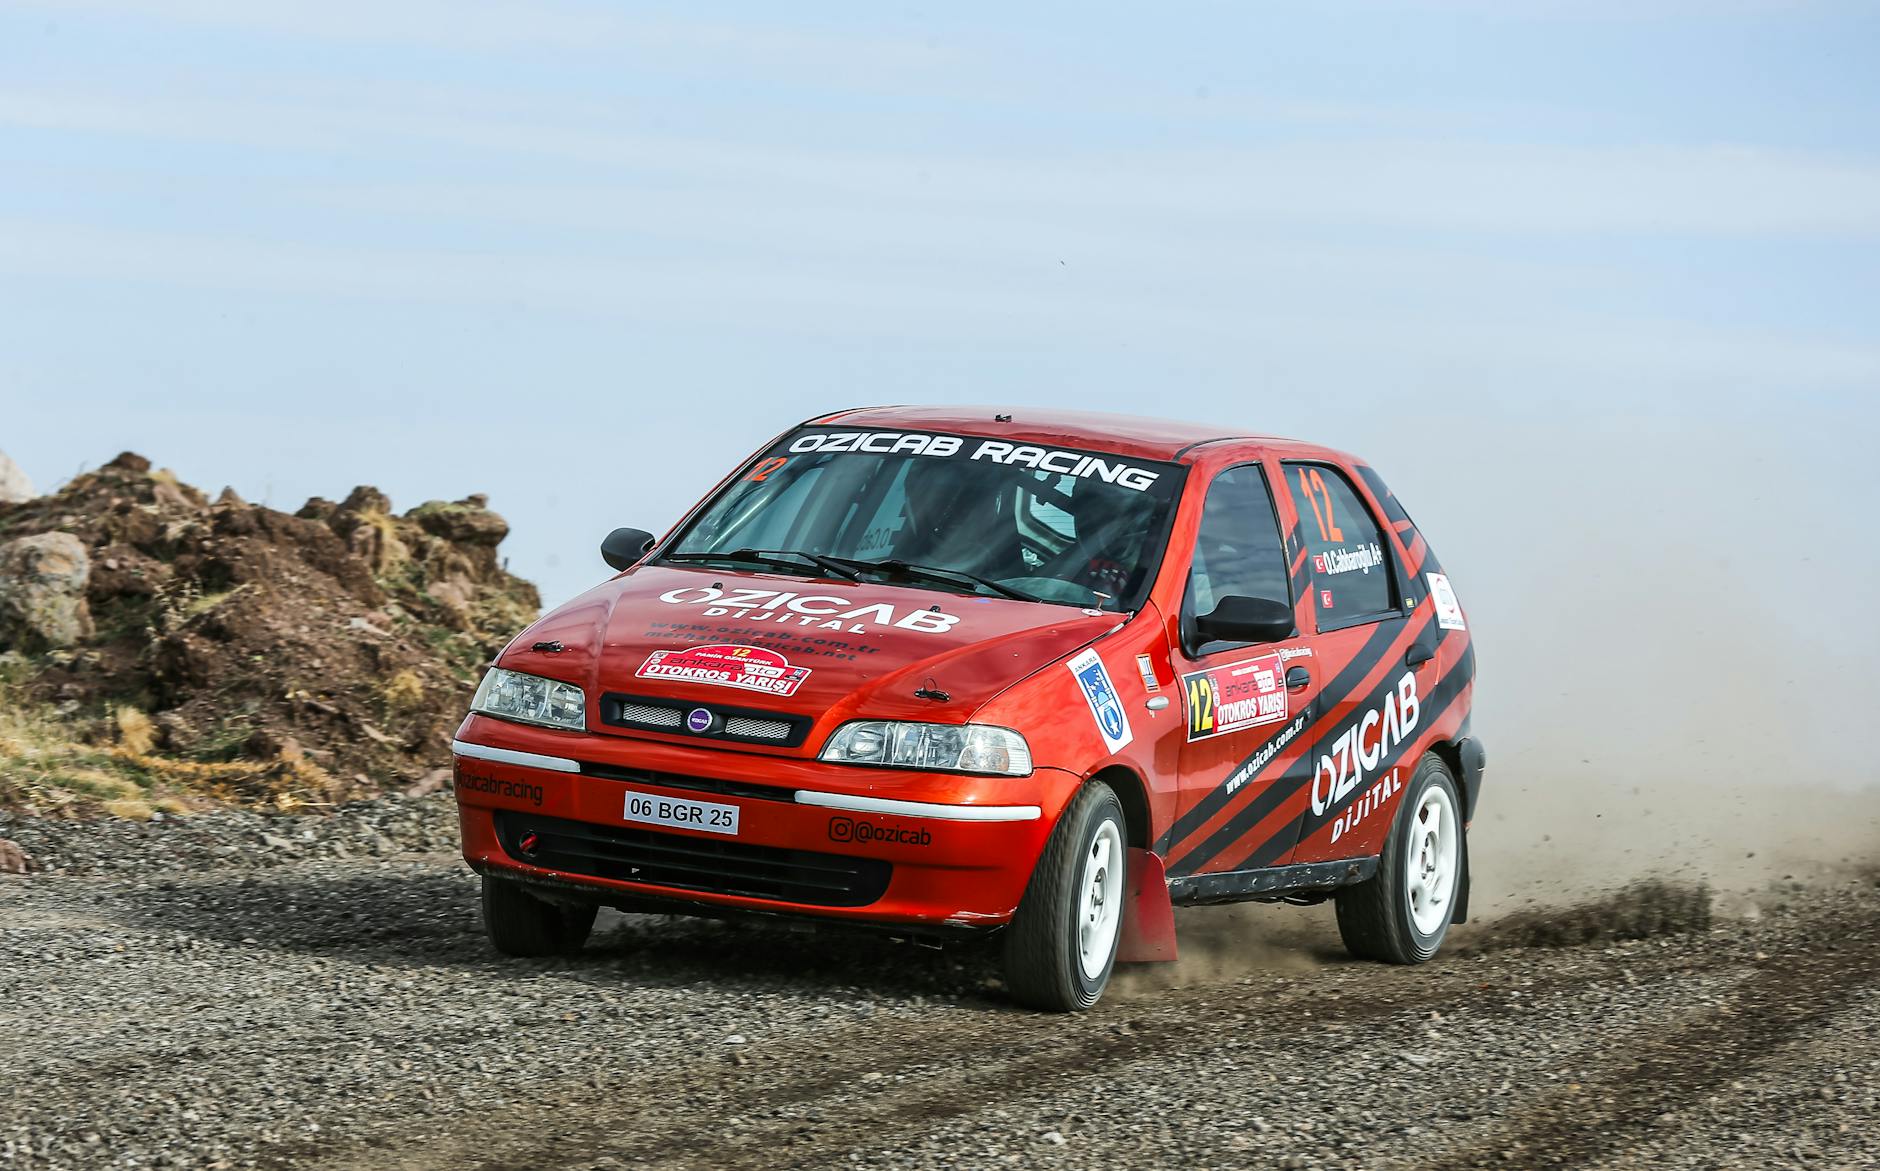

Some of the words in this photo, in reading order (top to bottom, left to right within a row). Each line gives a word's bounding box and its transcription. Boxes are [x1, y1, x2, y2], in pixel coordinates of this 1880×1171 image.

[743, 457, 788, 481] 12
[789, 433, 963, 457] OZICAB
[970, 441, 1160, 491] RACING
[1298, 468, 1344, 542] 12
[658, 588, 961, 633] OZICAB
[650, 622, 880, 654] www.ozicab.com.tr
[732, 648, 751, 657] 12
[646, 665, 731, 680] OTOKROS
[736, 674, 793, 692] YARIŞI
[670, 657, 743, 671] ankara
[1075, 656, 1097, 672] ANKARA
[1190, 679, 1214, 732] 12
[1218, 697, 1257, 725] OTOKROS
[1226, 715, 1304, 795] www.ozicab.com.tr
[1311, 671, 1420, 817] OZICAB
[630, 798, 652, 817] 06
[658, 802, 703, 824] BGR
[709, 809, 733, 828] 25
[855, 821, 932, 846] @ozicab
